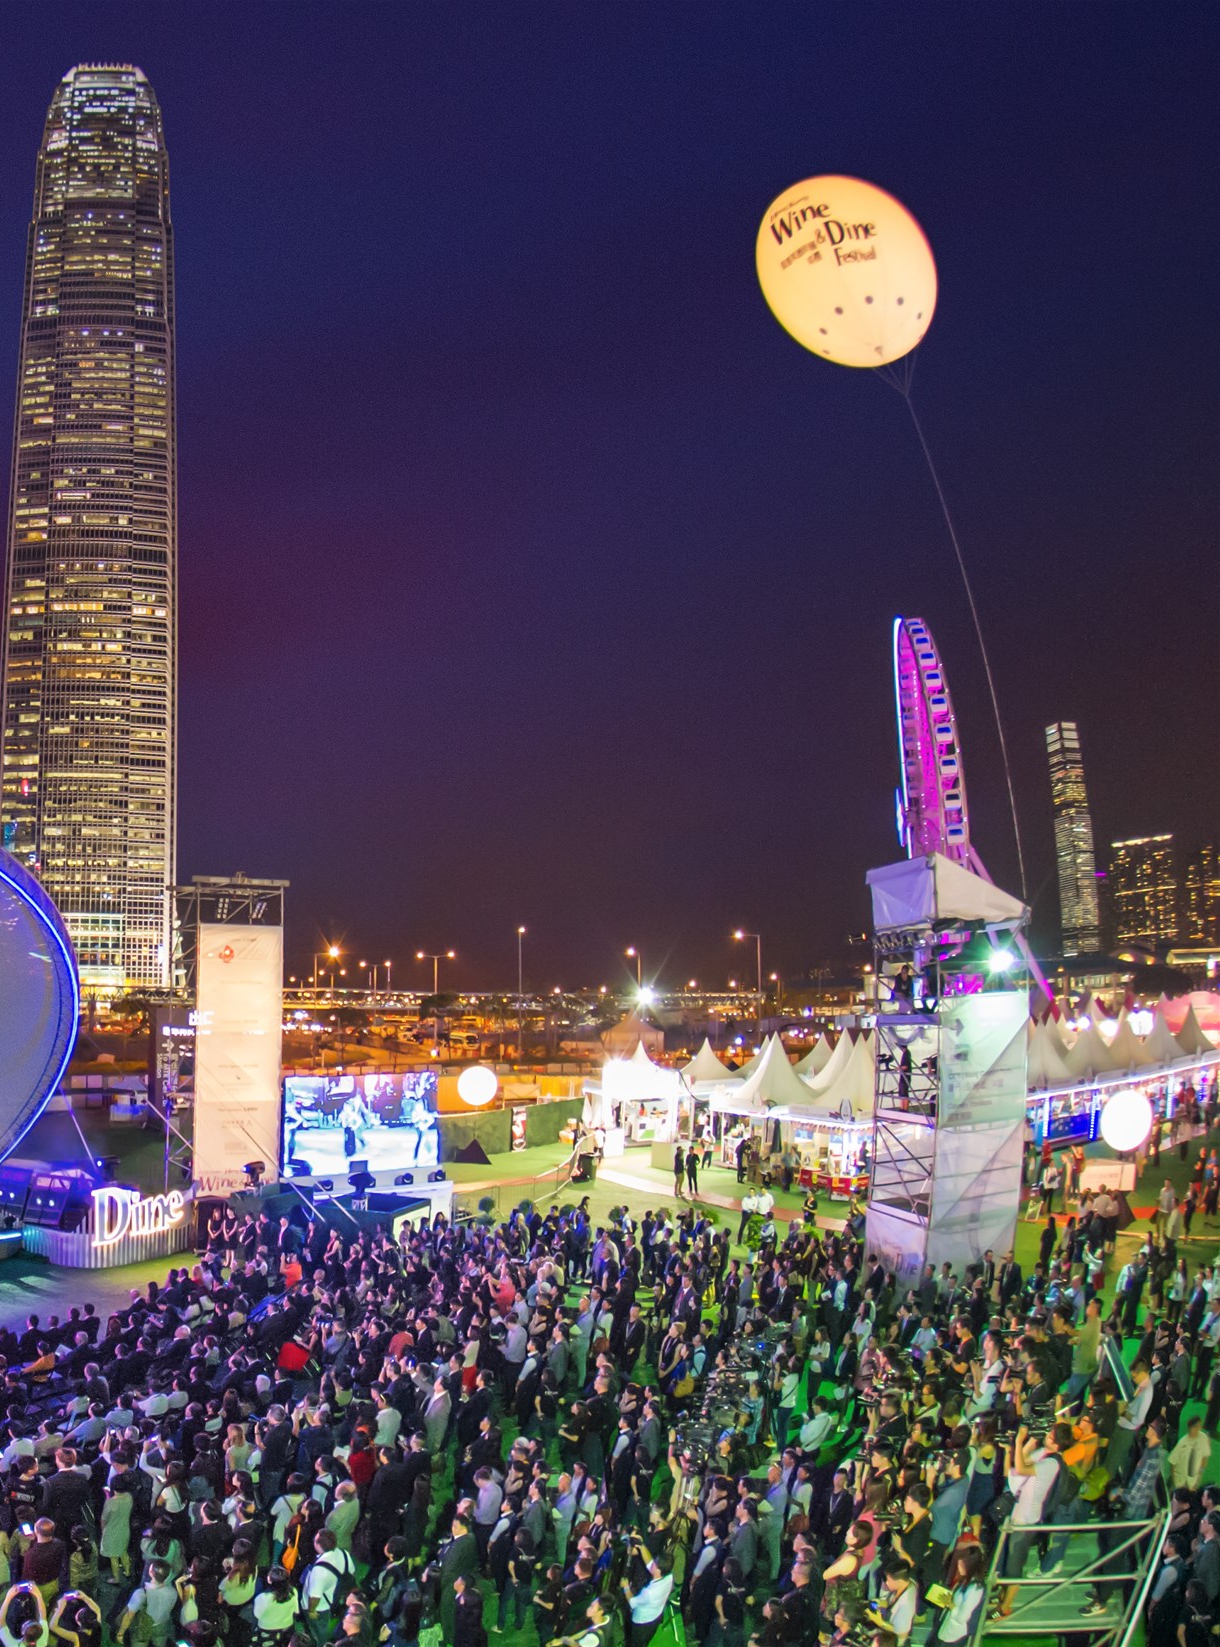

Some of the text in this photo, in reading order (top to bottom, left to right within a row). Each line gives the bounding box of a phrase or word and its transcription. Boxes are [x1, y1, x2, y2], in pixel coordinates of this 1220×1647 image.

[770, 203, 831, 246] Wine
[823, 219, 877, 246] Dine
[833, 245, 877, 267] Festival
[200, 1174, 236, 1192] Wine
[91, 1186, 185, 1247] Dine
